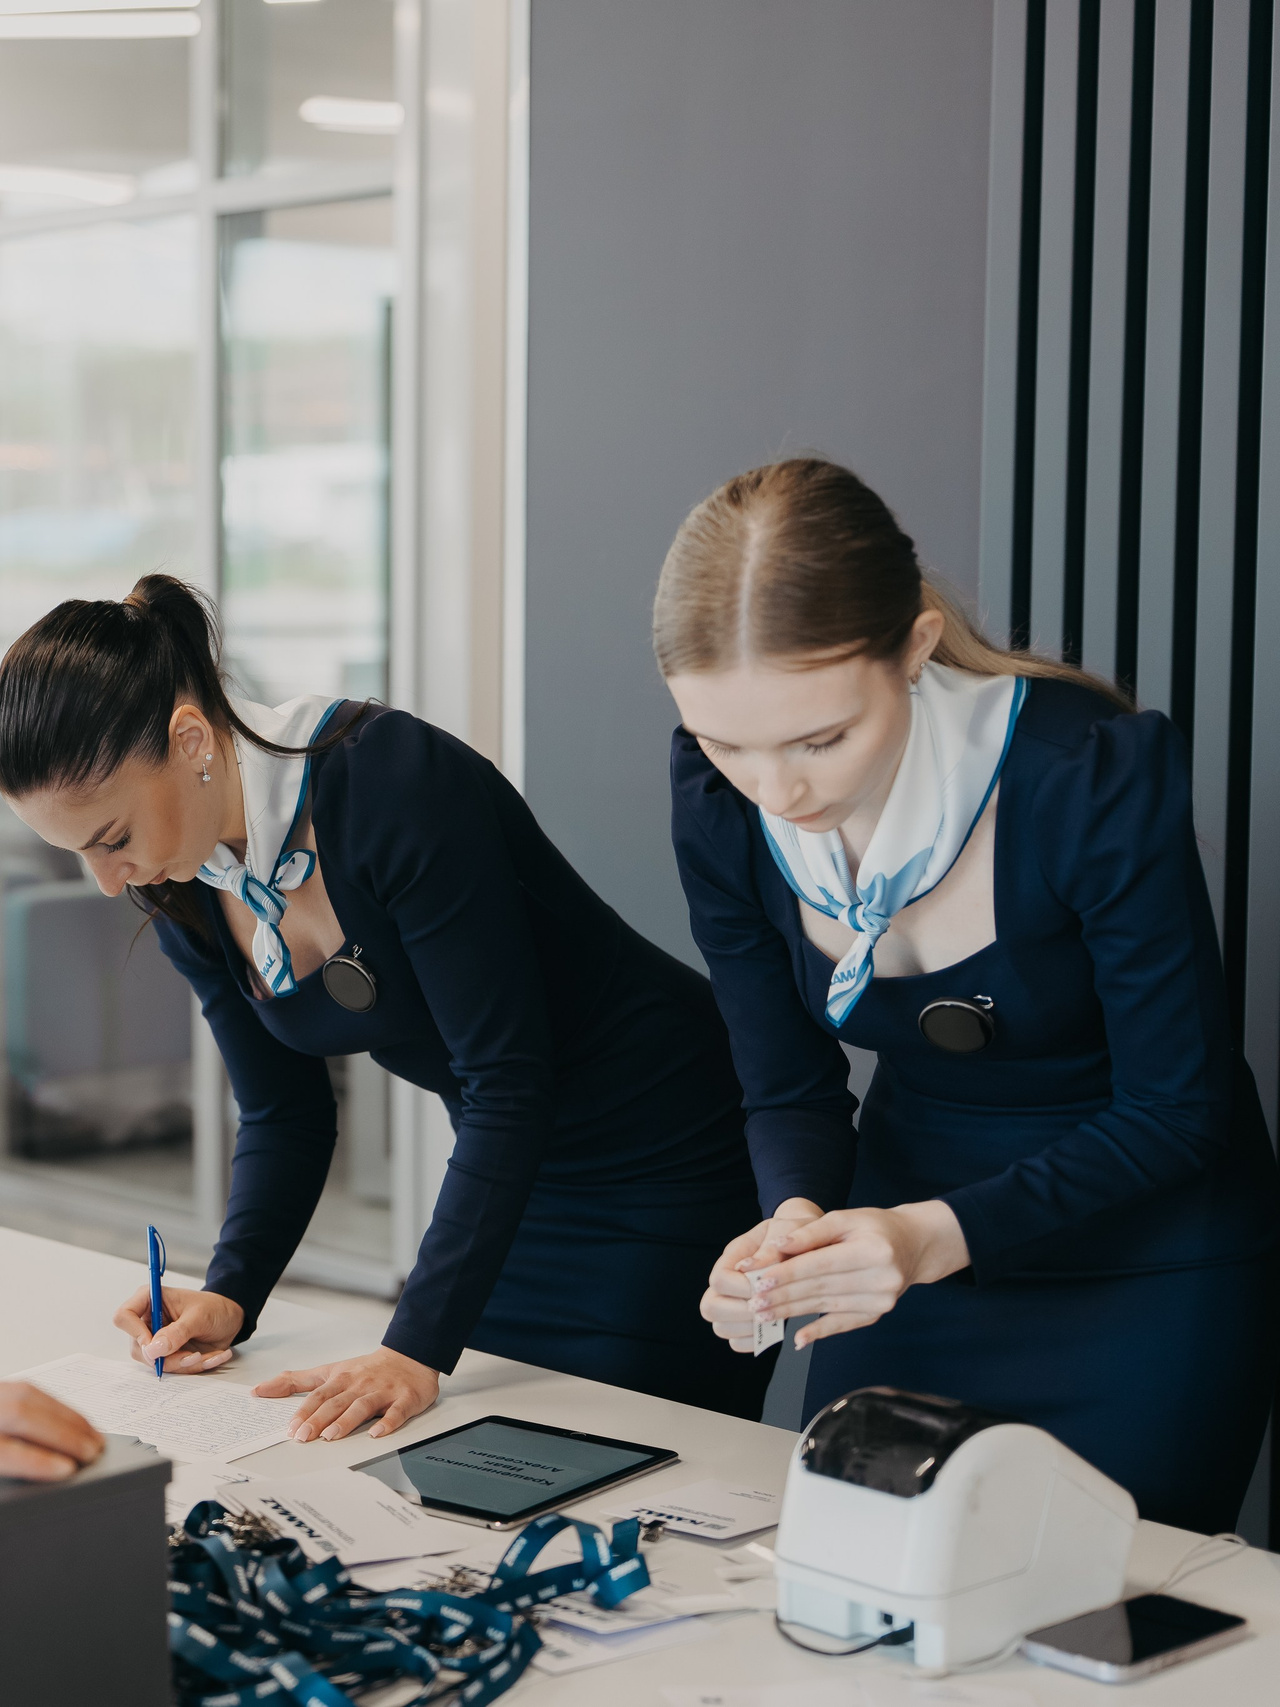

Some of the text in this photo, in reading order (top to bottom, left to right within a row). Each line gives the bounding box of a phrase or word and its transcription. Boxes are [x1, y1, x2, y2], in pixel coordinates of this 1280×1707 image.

[424, 1455, 555, 1487] Крашенинников
[468, 1450, 565, 1473] Алексеевич
[483, 1460, 524, 1472] Иван
